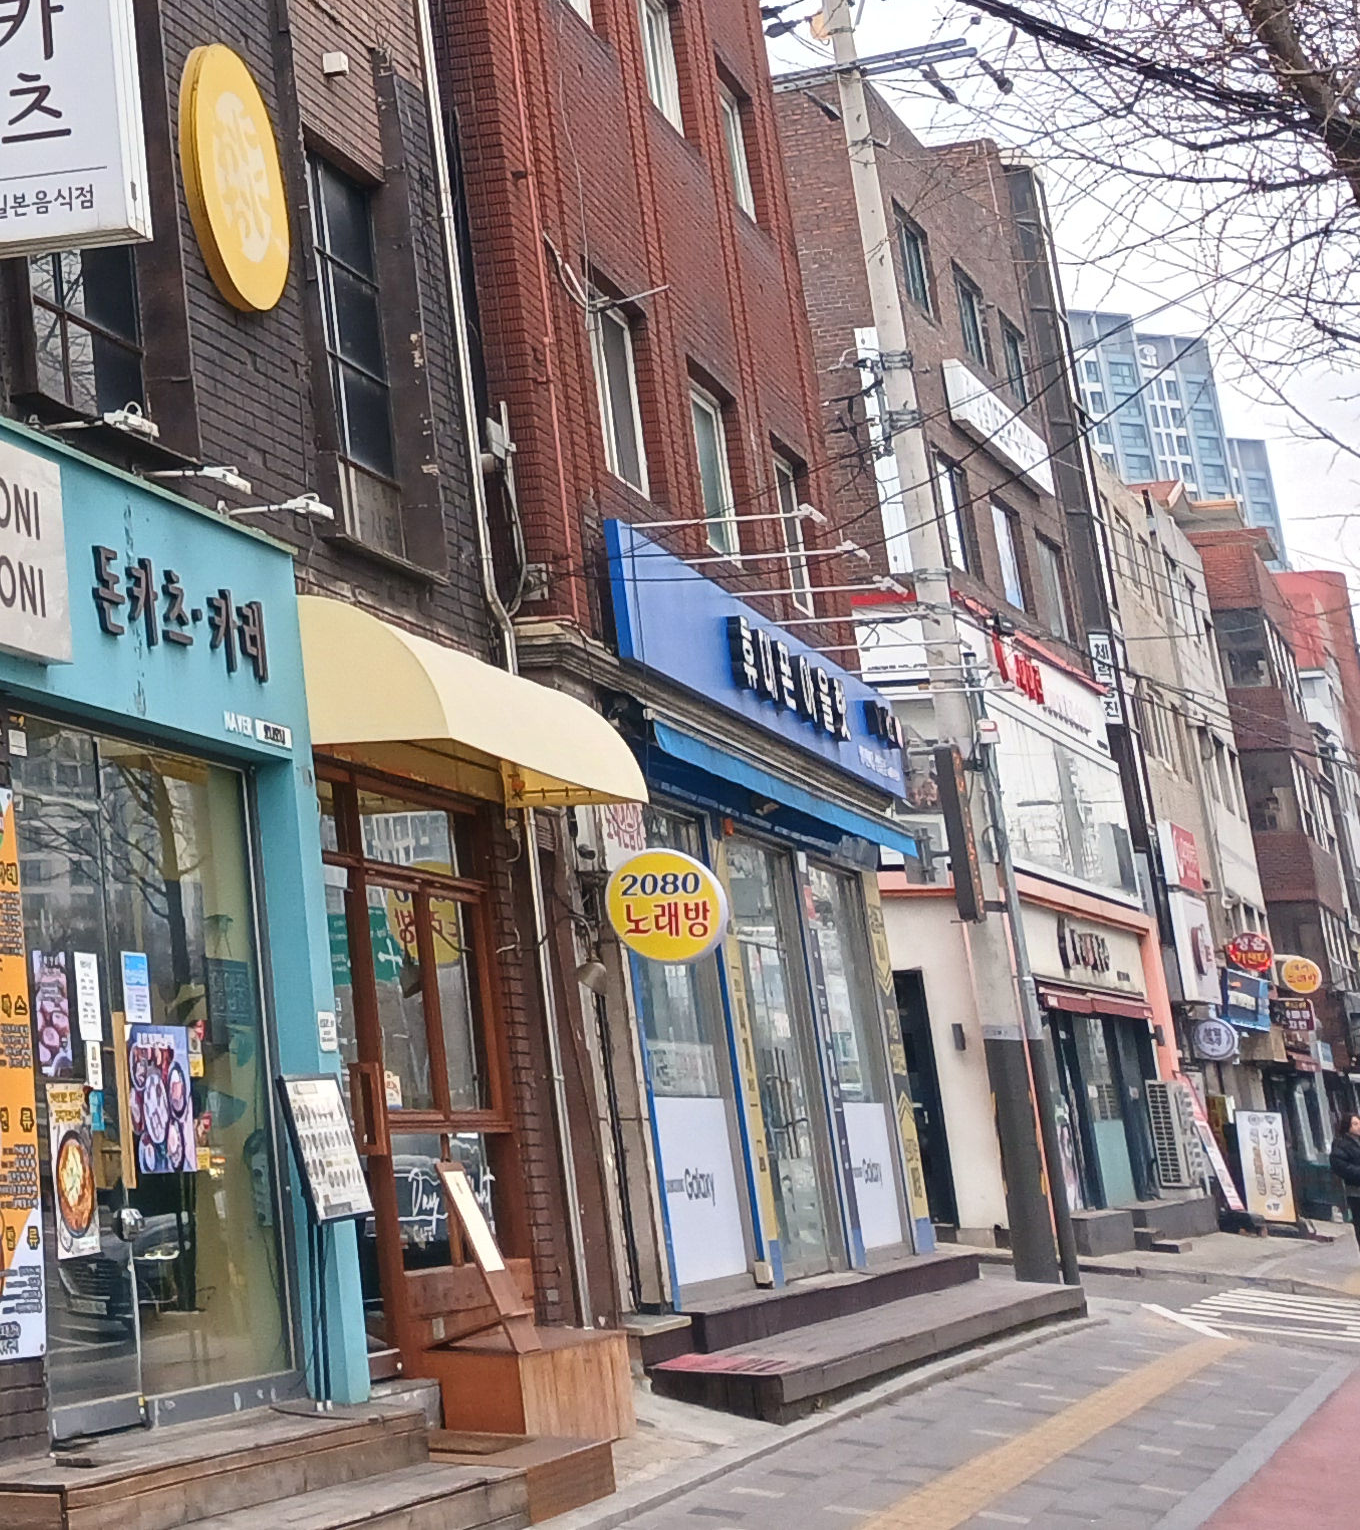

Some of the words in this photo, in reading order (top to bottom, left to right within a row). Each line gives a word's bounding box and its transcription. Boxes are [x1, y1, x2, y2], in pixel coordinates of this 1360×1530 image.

[620, 872, 700, 897] 2080
[623, 900, 711, 938] 노래방
[685, 1168, 715, 1206] Galaxy
